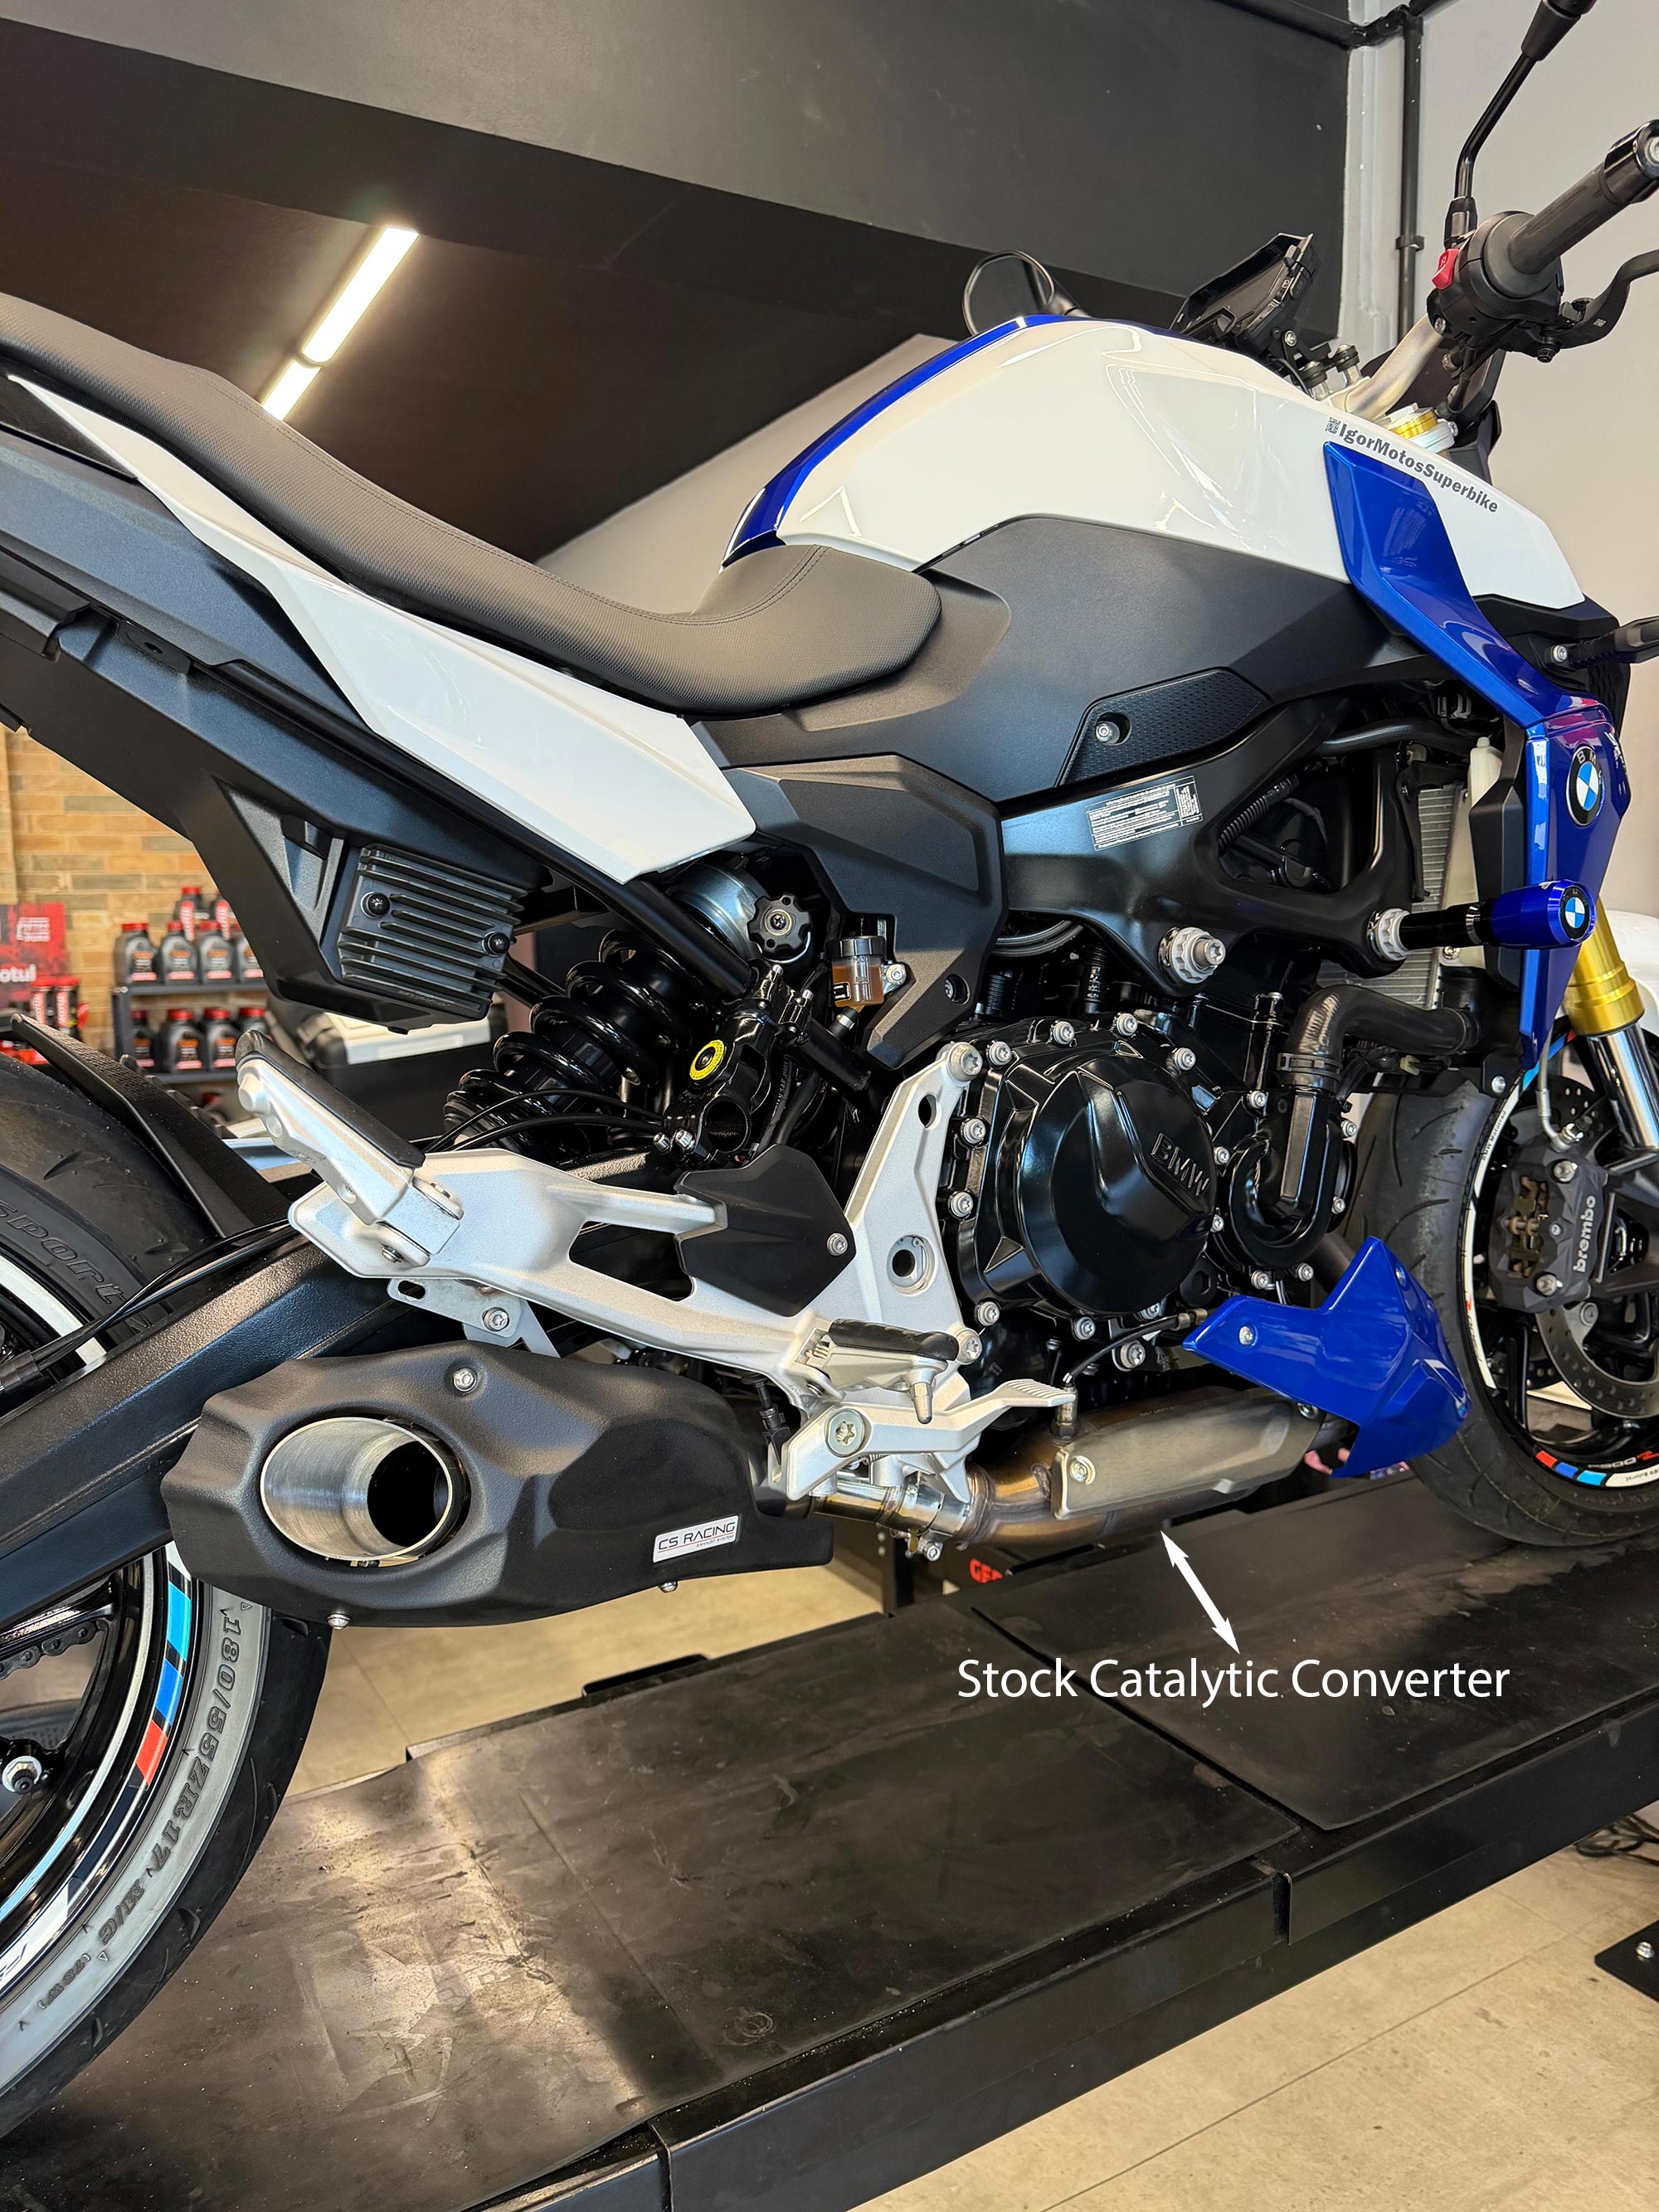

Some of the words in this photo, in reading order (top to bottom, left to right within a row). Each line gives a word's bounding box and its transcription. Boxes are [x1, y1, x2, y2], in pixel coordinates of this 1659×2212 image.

[1339, 423, 1498, 513] IgorMotosSuperbike
[1151, 1133, 1209, 1196] BMW
[1573, 1195, 1596, 1273] brembo
[659, 1536, 679, 1550] CS
[684, 1522, 735, 1544] RACING
